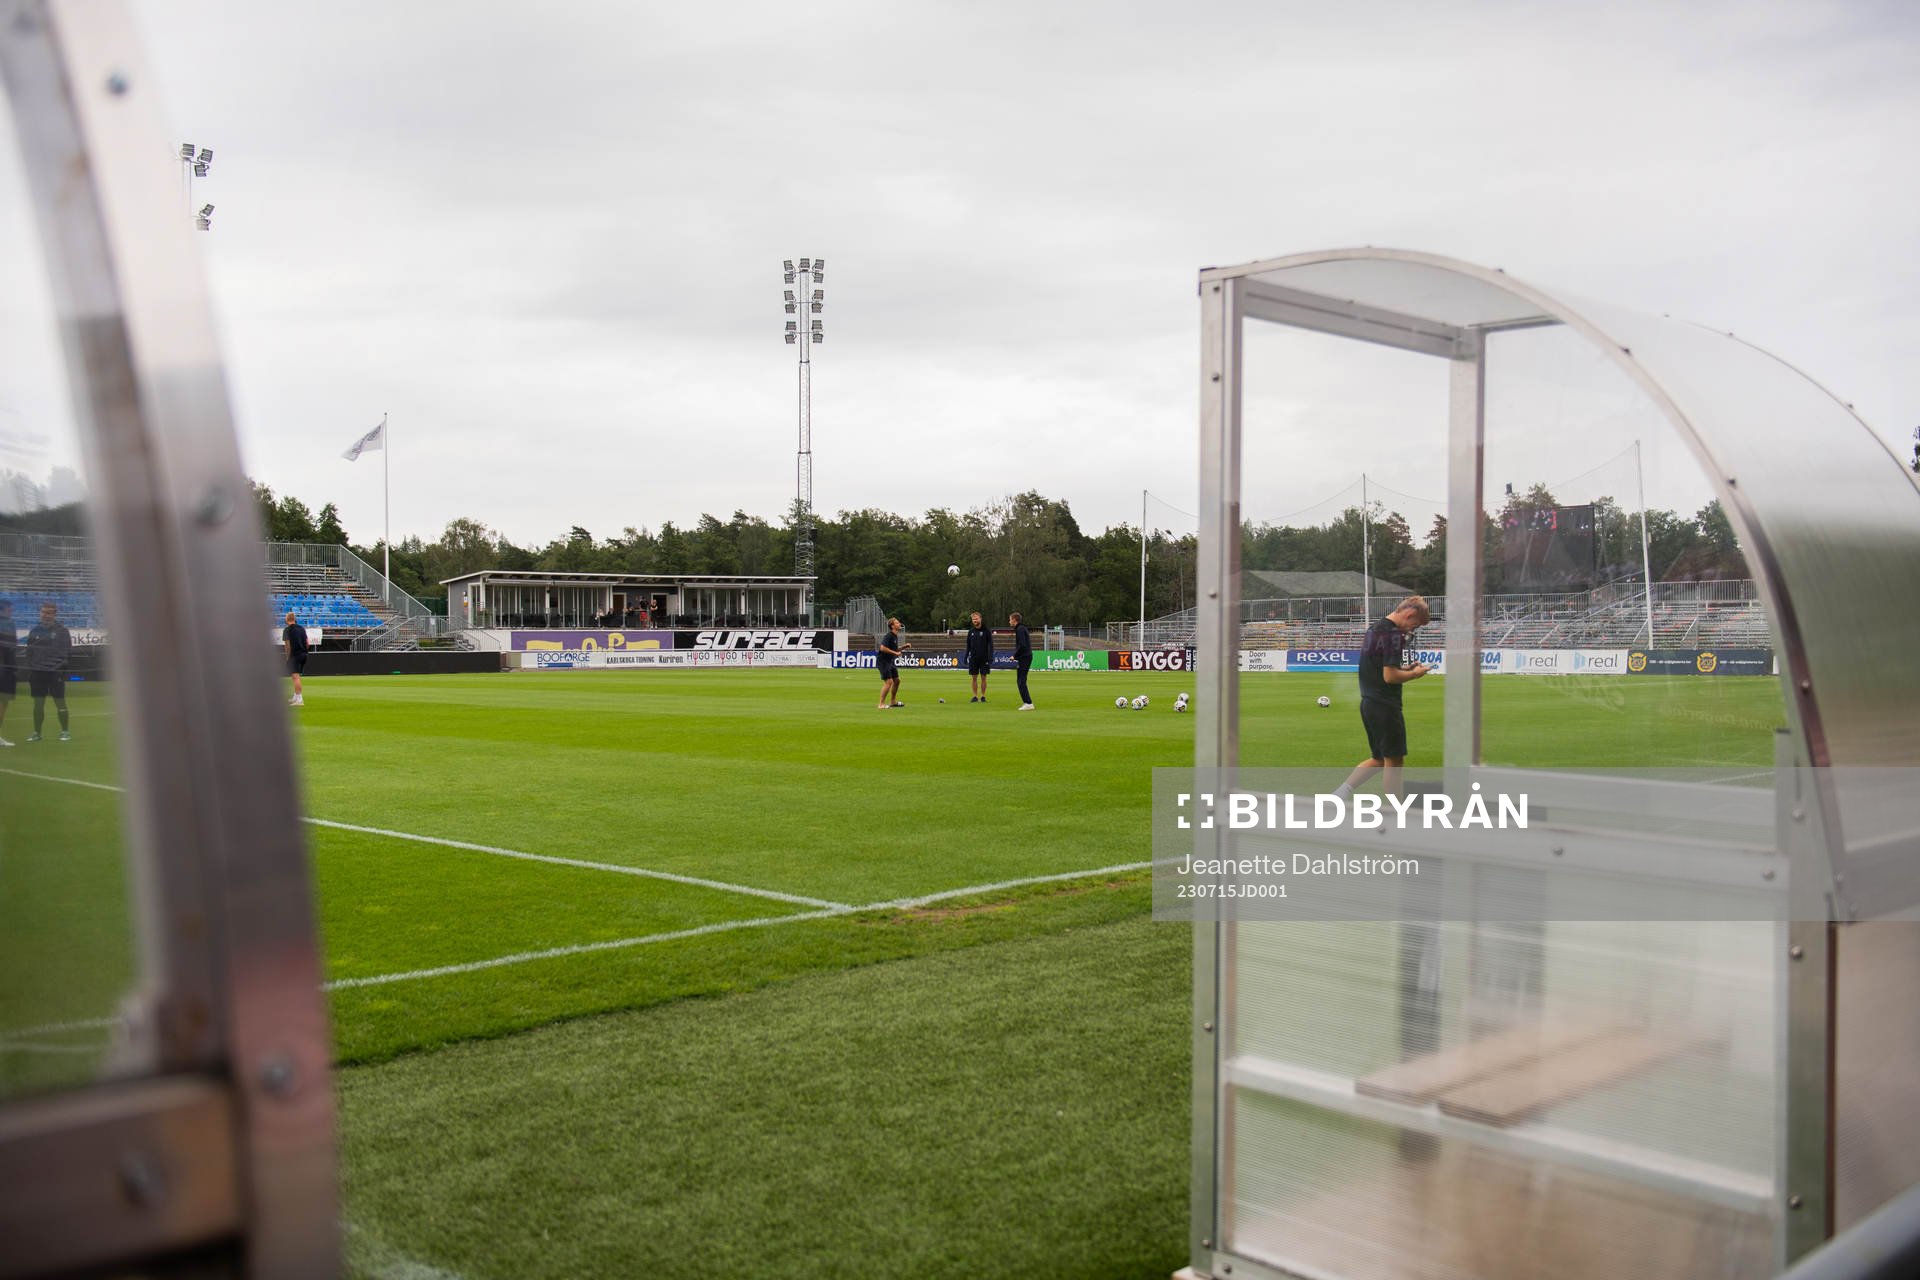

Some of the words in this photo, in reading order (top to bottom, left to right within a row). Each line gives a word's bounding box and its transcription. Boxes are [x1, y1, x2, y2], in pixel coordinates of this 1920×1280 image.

[658, 654, 683, 664] Kuriren
[926, 653, 952, 667] askås
[1131, 651, 1183, 670] BYGG
[1248, 650, 1266, 658] Doors
[1529, 654, 1558, 668] real
[1588, 654, 1618, 668] real
